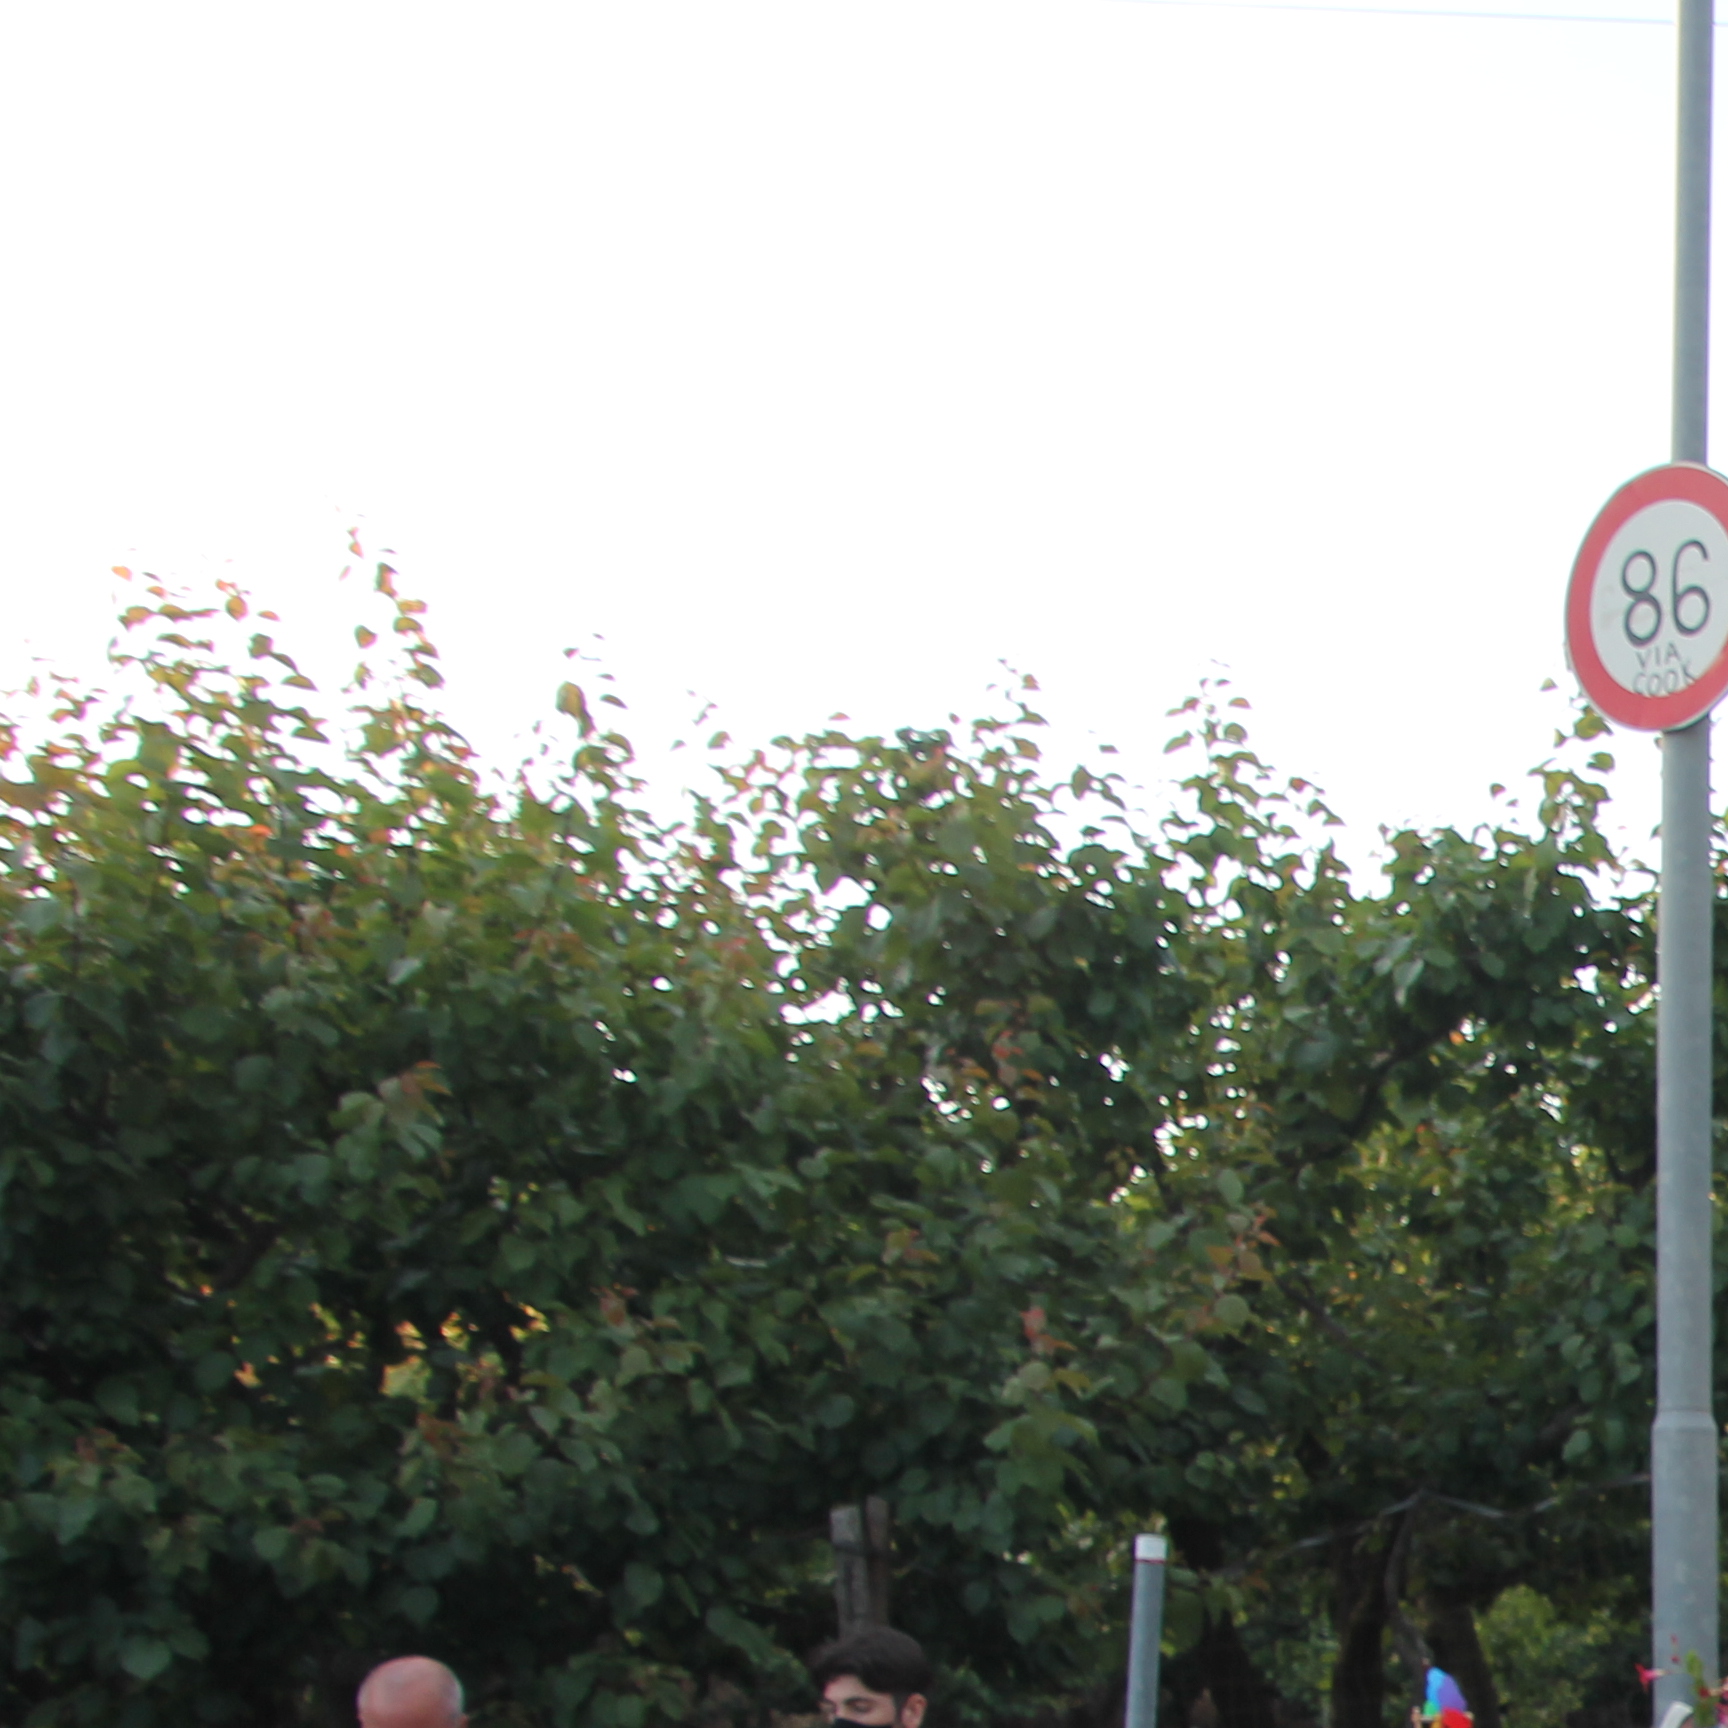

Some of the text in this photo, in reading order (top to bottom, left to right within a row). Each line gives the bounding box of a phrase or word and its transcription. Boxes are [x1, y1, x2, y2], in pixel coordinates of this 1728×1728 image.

[1621, 539, 1711, 648] 86
[1635, 641, 1682, 669] VIA
[1633, 659, 1696, 696] COOK
